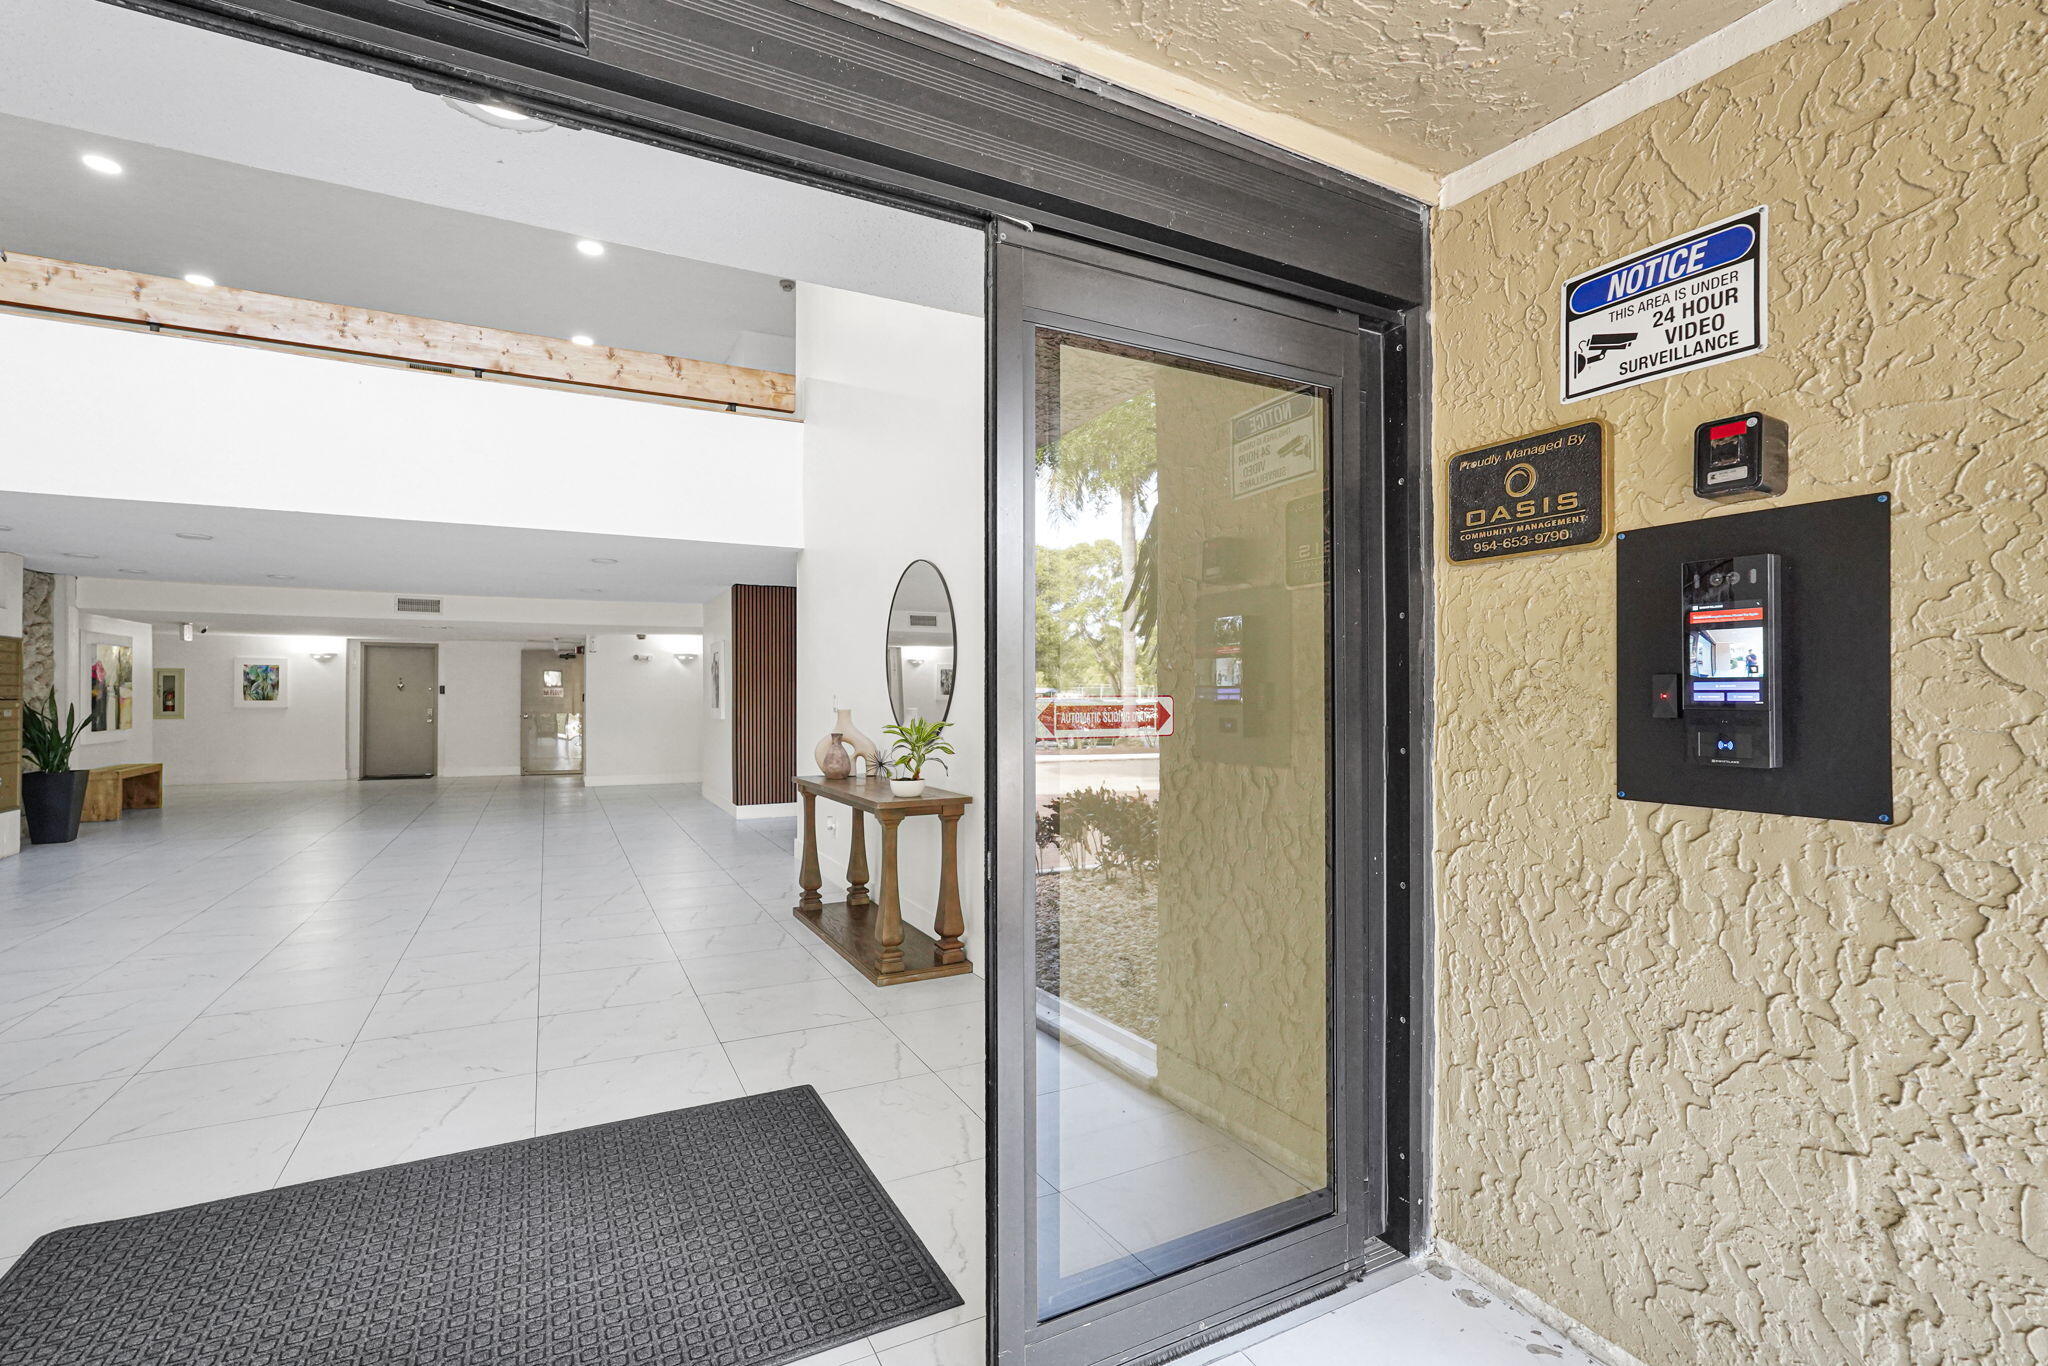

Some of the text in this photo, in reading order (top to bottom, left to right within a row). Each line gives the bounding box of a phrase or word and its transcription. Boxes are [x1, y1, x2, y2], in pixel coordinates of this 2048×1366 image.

[1606, 240, 1708, 302] NOTICE
[1609, 270, 1739, 322] THIS AREA IS UNDER
[1652, 287, 1739, 328] 24 HOUR
[1665, 313, 1725, 345] VIDEO
[1619, 330, 1739, 376] SURVEILLANCE
[1459, 433, 1587, 472] Proudly Managed By
[1466, 491, 1578, 527] OASIS
[1460, 515, 1585, 541] COMMUNITY MANAGEMENT
[1473, 529, 1570, 553] 954-653-9790
[1060, 711, 1102, 724] AUTOMATIC
